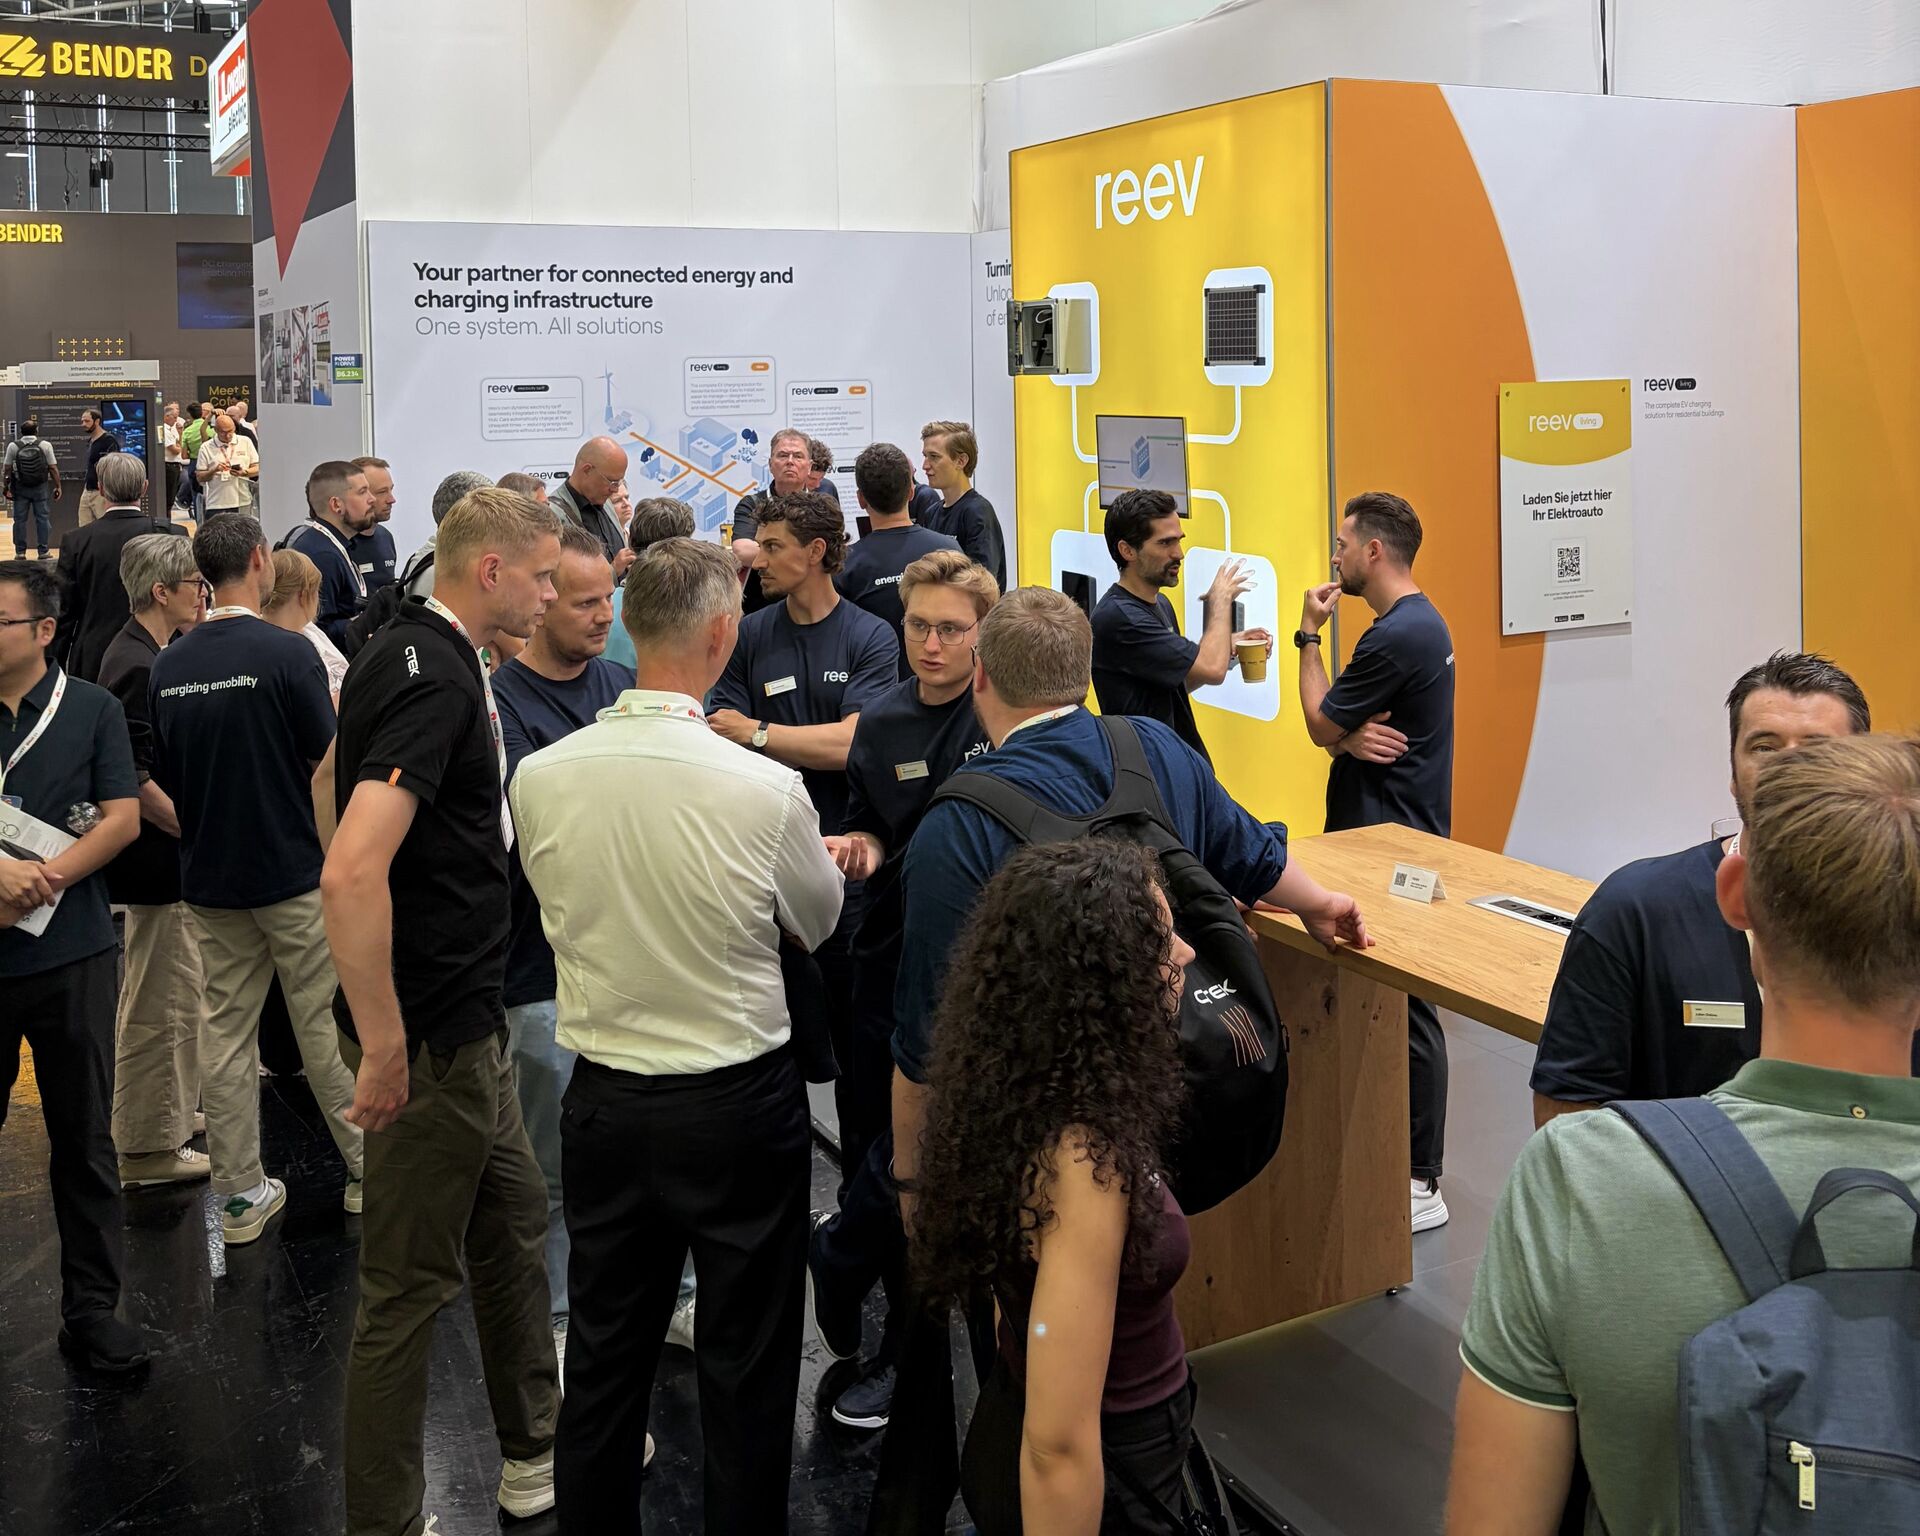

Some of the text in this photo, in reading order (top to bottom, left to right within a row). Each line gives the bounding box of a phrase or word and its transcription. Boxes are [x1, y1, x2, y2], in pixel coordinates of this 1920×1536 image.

[52, 42, 173, 80] BENDER
[1095, 156, 1204, 230] reev
[0, 224, 63, 242] BENDER
[413, 262, 793, 288] Your partner for connected energy and
[414, 290, 653, 312] charging infrastructure
[986, 310, 996, 326] of
[416, 317, 663, 339] One system. All solutions
[690, 364, 713, 372] reev
[209, 385, 249, 395] Meet &
[488, 385, 513, 393] reev
[792, 388, 814, 396] reev
[1644, 378, 1674, 392] reev
[1689, 400, 1711, 408] charging
[1528, 414, 1597, 433] reev living
[1522, 489, 1612, 506] Laden Sie jetzt hier
[1532, 506, 1603, 521] Ihr Elektroauto
[405, 645, 420, 678] CTEK
[824, 670, 850, 682] ree
[161, 675, 258, 698] energizing emobility
